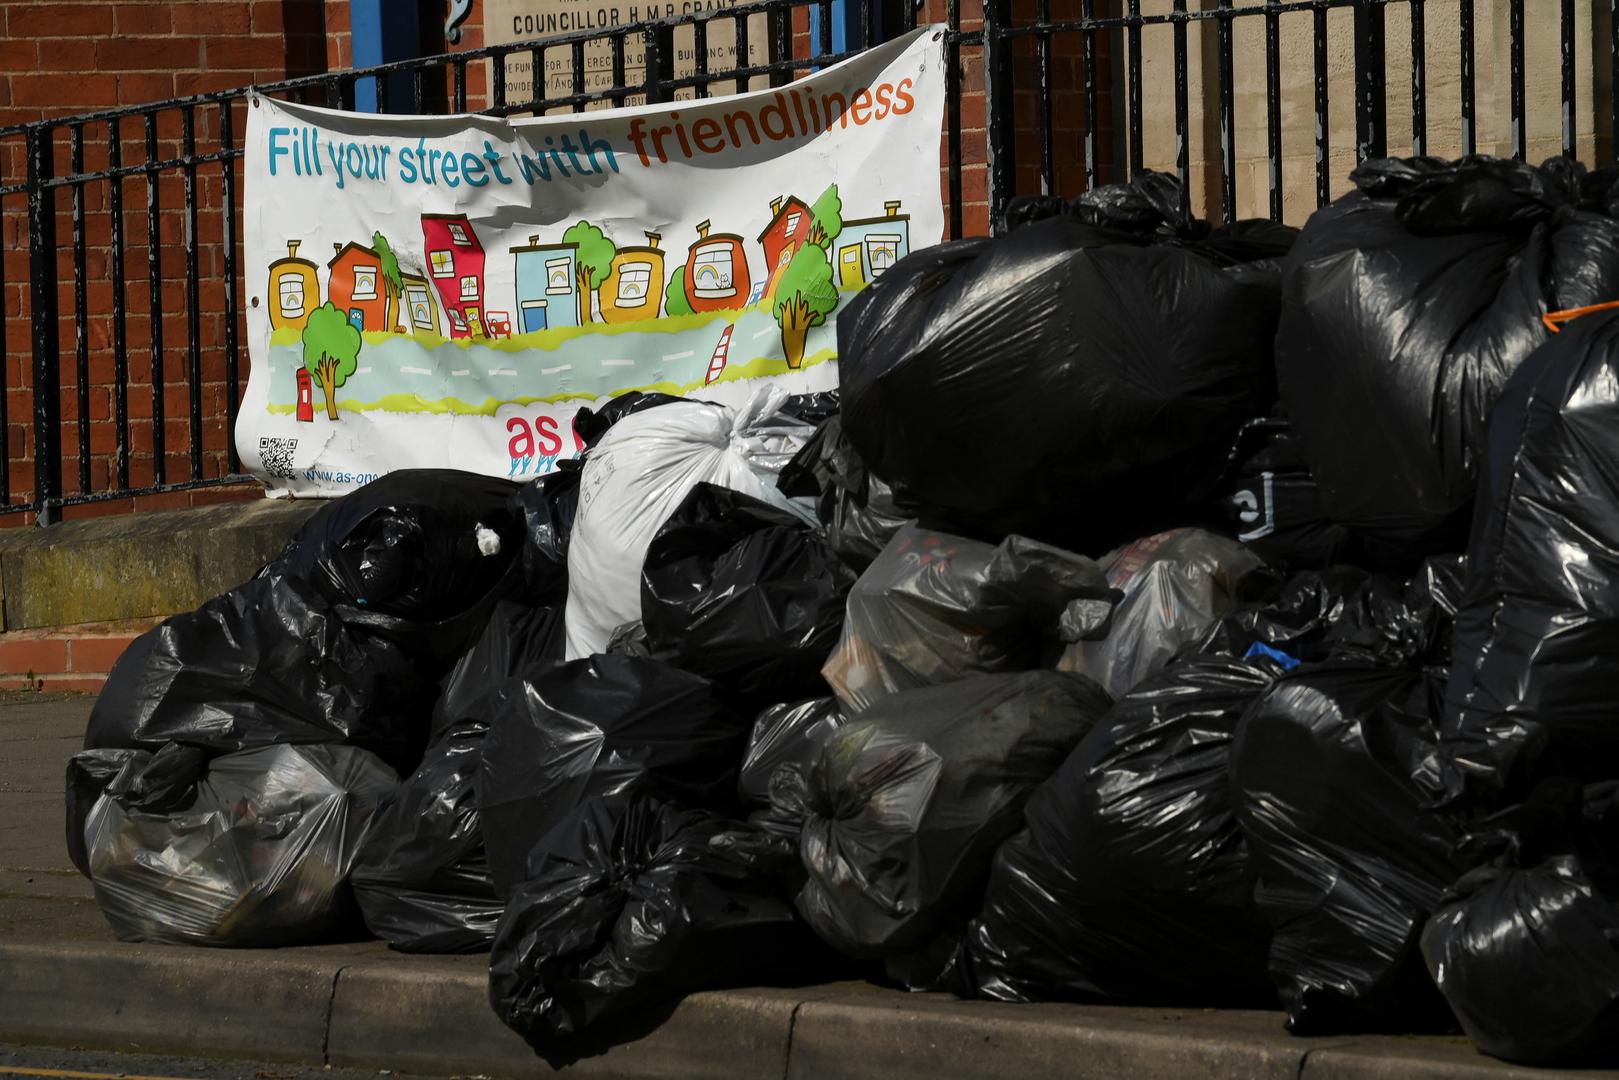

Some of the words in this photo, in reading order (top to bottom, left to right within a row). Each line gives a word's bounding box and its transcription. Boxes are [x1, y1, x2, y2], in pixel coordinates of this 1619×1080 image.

[513, 8, 619, 35] COUNCILLOR
[268, 127, 323, 177] Fill
[328, 139, 390, 190] your
[399, 136, 512, 188] street
[513, 129, 620, 186] with
[627, 77, 915, 167] friendliness
[506, 415, 562, 459] as
